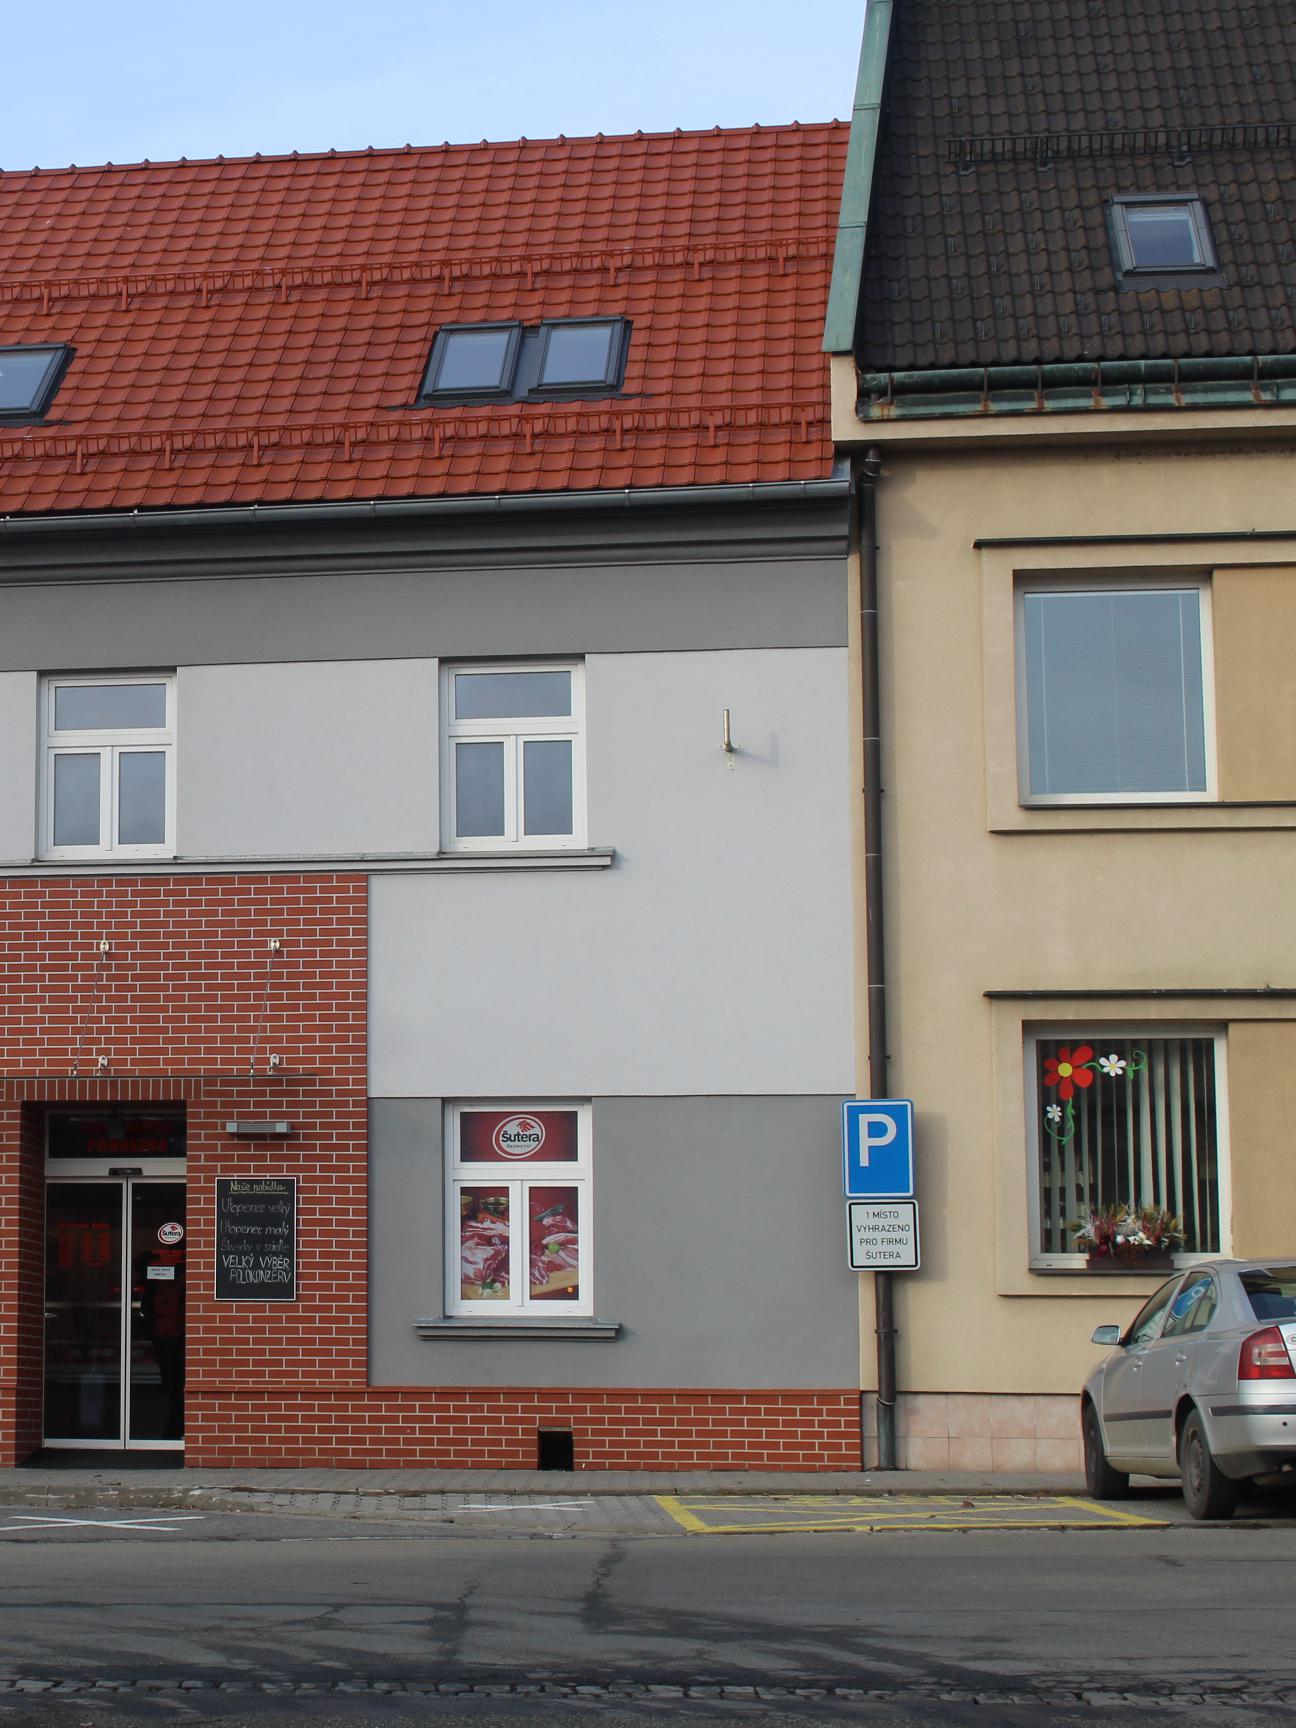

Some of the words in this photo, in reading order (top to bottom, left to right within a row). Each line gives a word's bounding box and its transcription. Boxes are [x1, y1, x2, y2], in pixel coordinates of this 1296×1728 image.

[501, 1130, 540, 1142] Šutera
[858, 1113, 897, 1167] P
[230, 1181, 250, 1192] Naše
[221, 1197, 265, 1216] Utopenec
[866, 1211, 870, 1219] 1
[872, 1209, 899, 1219] MÍSTO
[221, 1219, 262, 1234] Utopenec
[265, 1220, 290, 1239] malý
[856, 1224, 910, 1233] VYHRAZENO
[859, 1238, 878, 1246] PRO
[881, 1237, 909, 1246] FIRMU
[222, 1253, 254, 1268] VELKÝ
[865, 1250, 901, 1260] ŠUTERA
